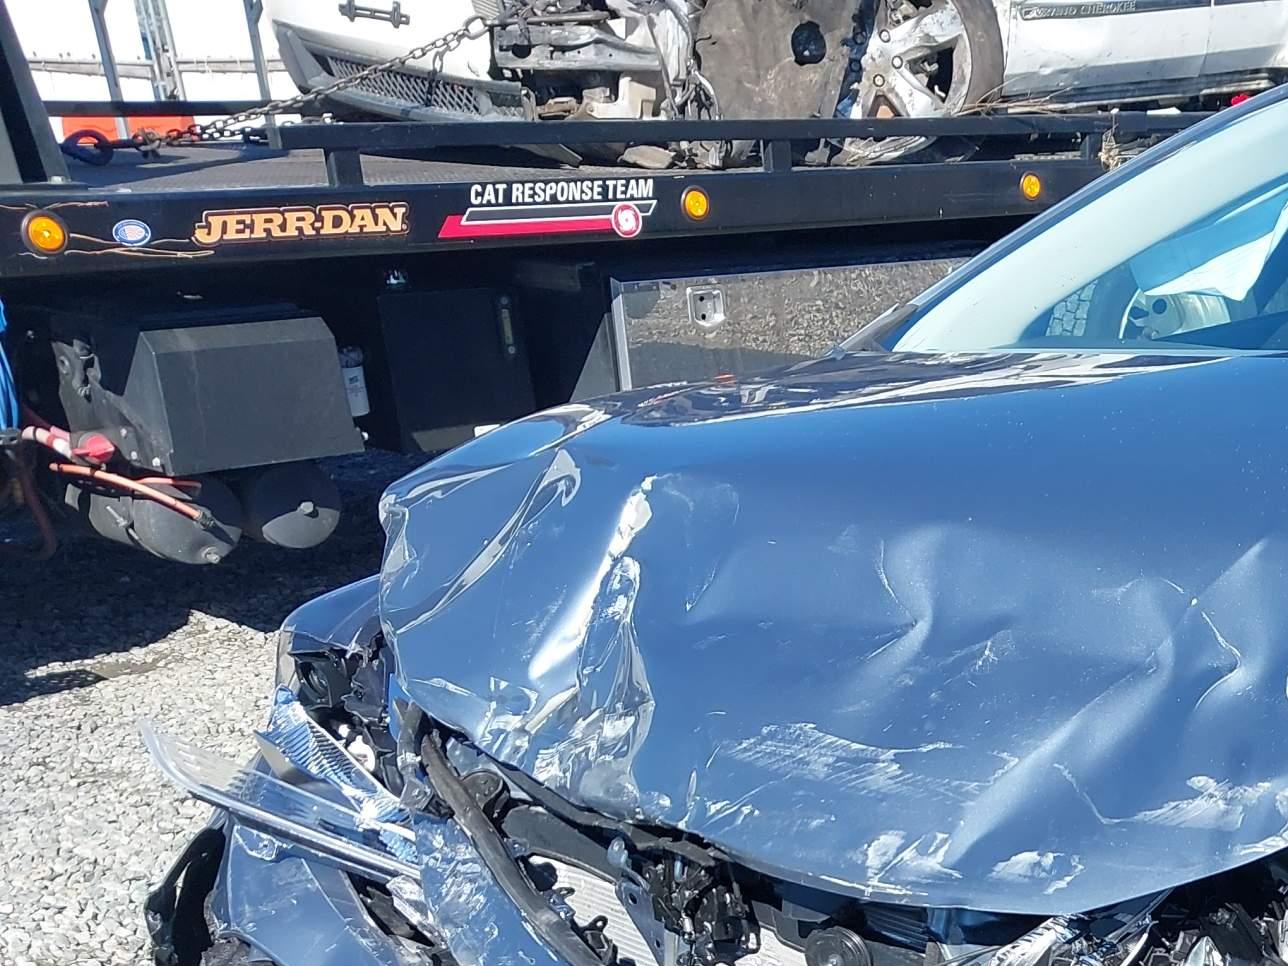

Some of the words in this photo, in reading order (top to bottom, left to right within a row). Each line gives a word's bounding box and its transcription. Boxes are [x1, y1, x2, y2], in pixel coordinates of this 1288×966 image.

[470, 183, 507, 205] CAT
[511, 180, 602, 203] RESPONSE
[606, 178, 654, 200] TEAM
[194, 206, 406, 244] JERR-DAN
